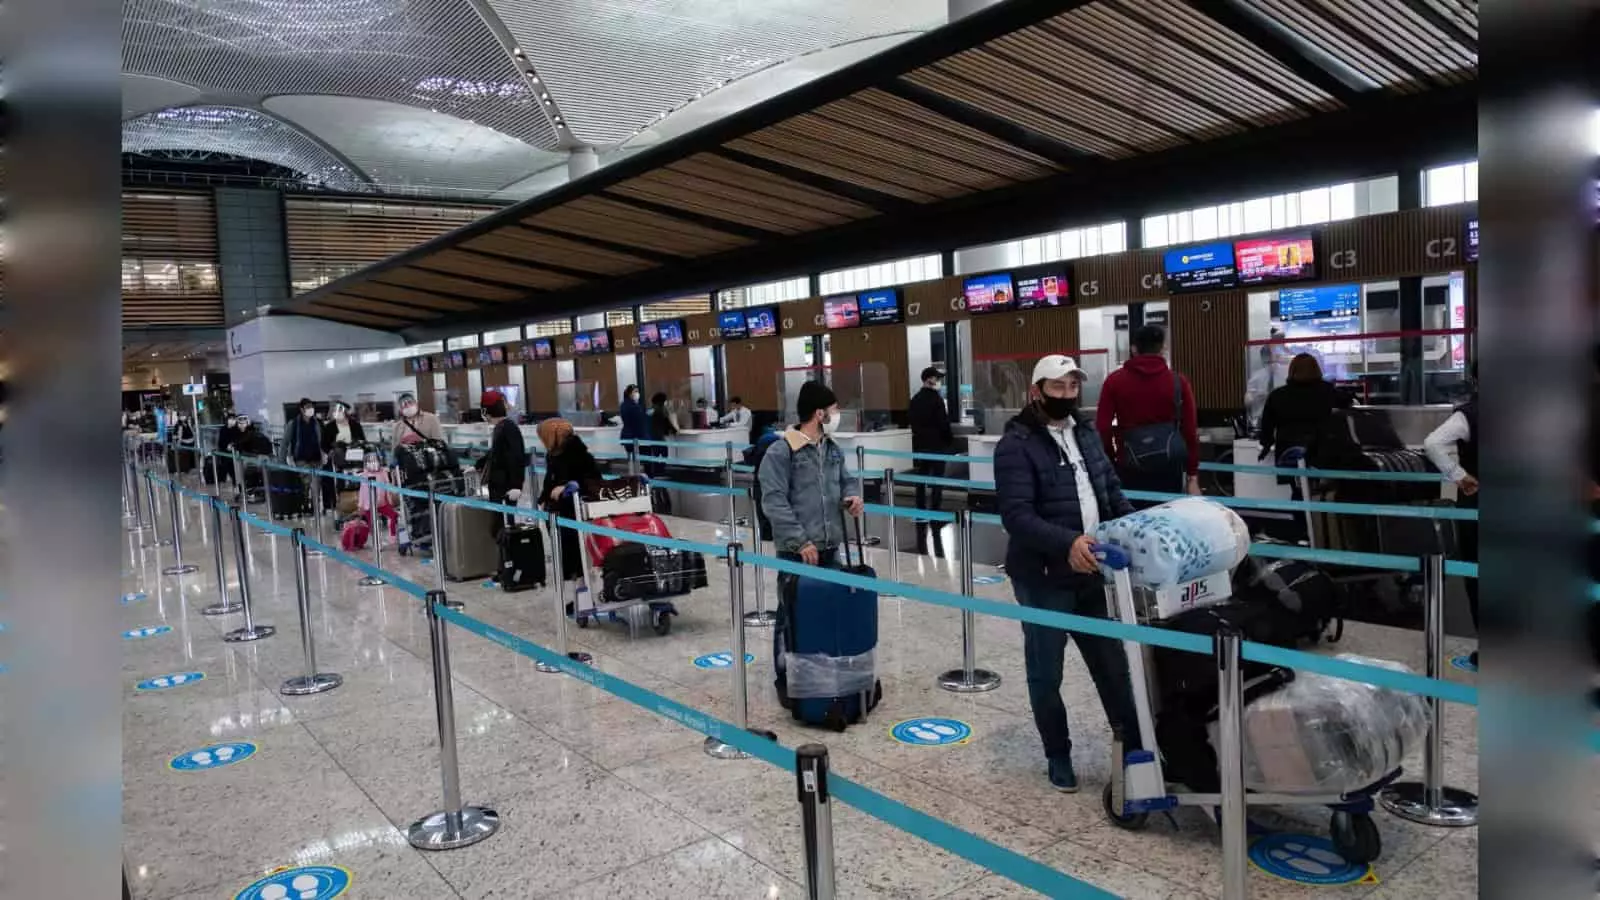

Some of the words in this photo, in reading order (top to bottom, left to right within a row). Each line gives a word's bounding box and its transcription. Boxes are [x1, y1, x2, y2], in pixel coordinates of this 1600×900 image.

[1425, 237, 1456, 258] C2
[1330, 250, 1357, 269] C3
[1080, 281, 1099, 296] C5
[1141, 274, 1163, 290] C4
[907, 302, 920, 316] C7
[951, 297, 966, 311] C6
[782, 318, 794, 329] C9
